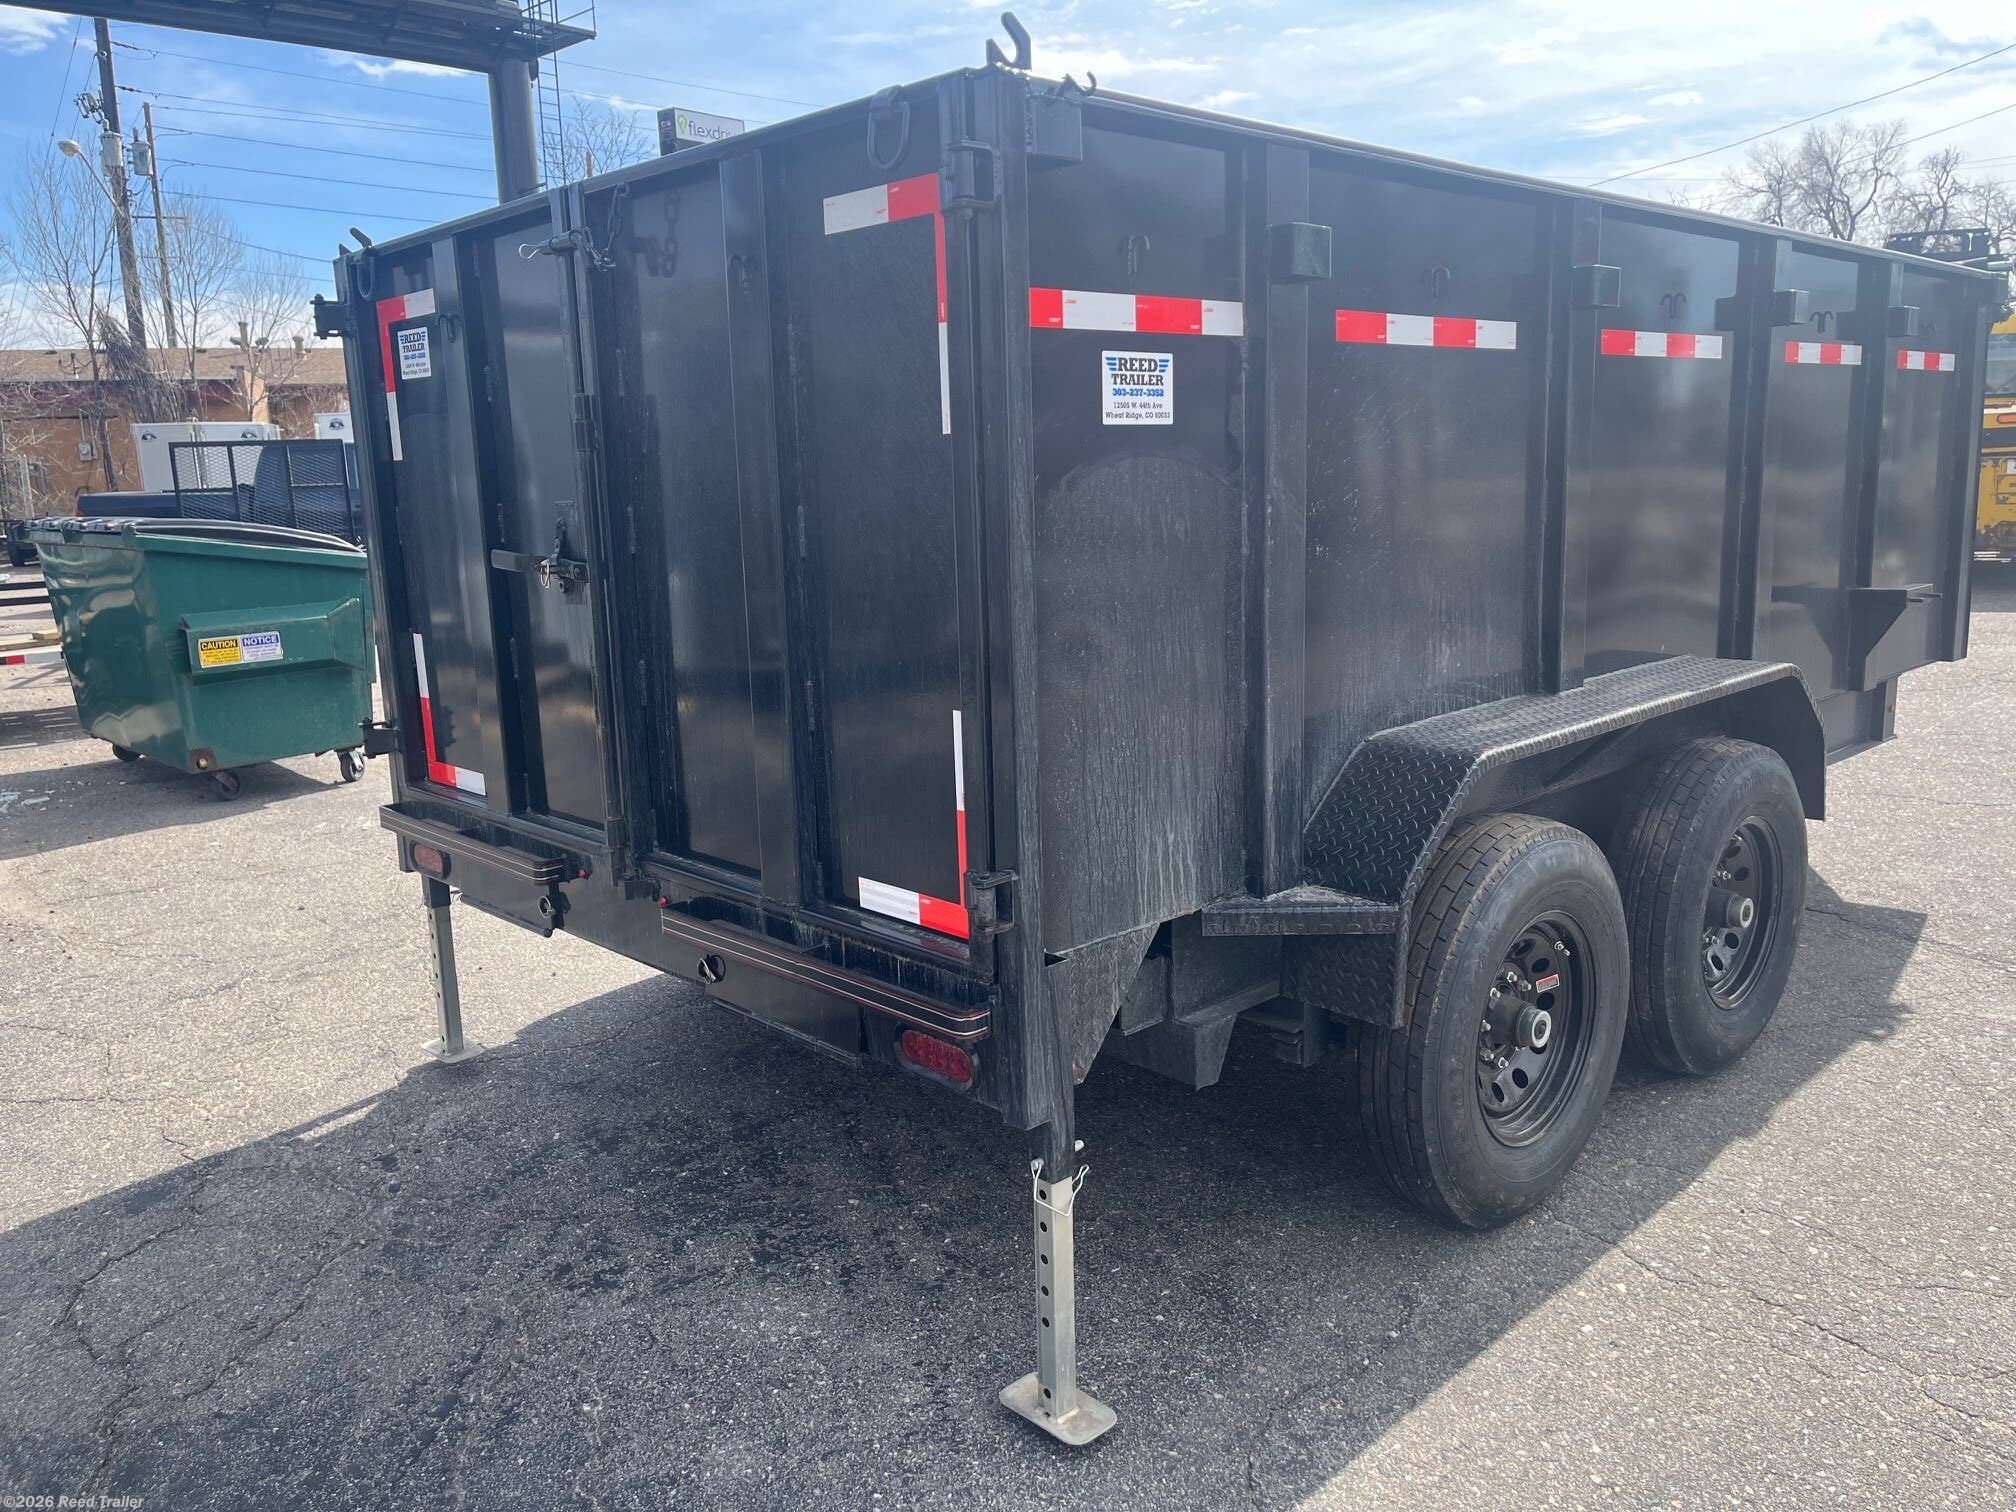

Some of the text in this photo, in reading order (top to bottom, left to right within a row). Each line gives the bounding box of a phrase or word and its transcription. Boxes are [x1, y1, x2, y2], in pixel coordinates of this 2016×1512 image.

[404, 332, 421, 343] REED
[403, 343, 425, 353] TRAILER
[1117, 357, 1158, 372] REED
[1111, 374, 1164, 386] TRAILER
[1112, 388, 1164, 397] 303-237-3352
[201, 640, 236, 650] CAUTION
[244, 636, 277, 646] NOTICE
